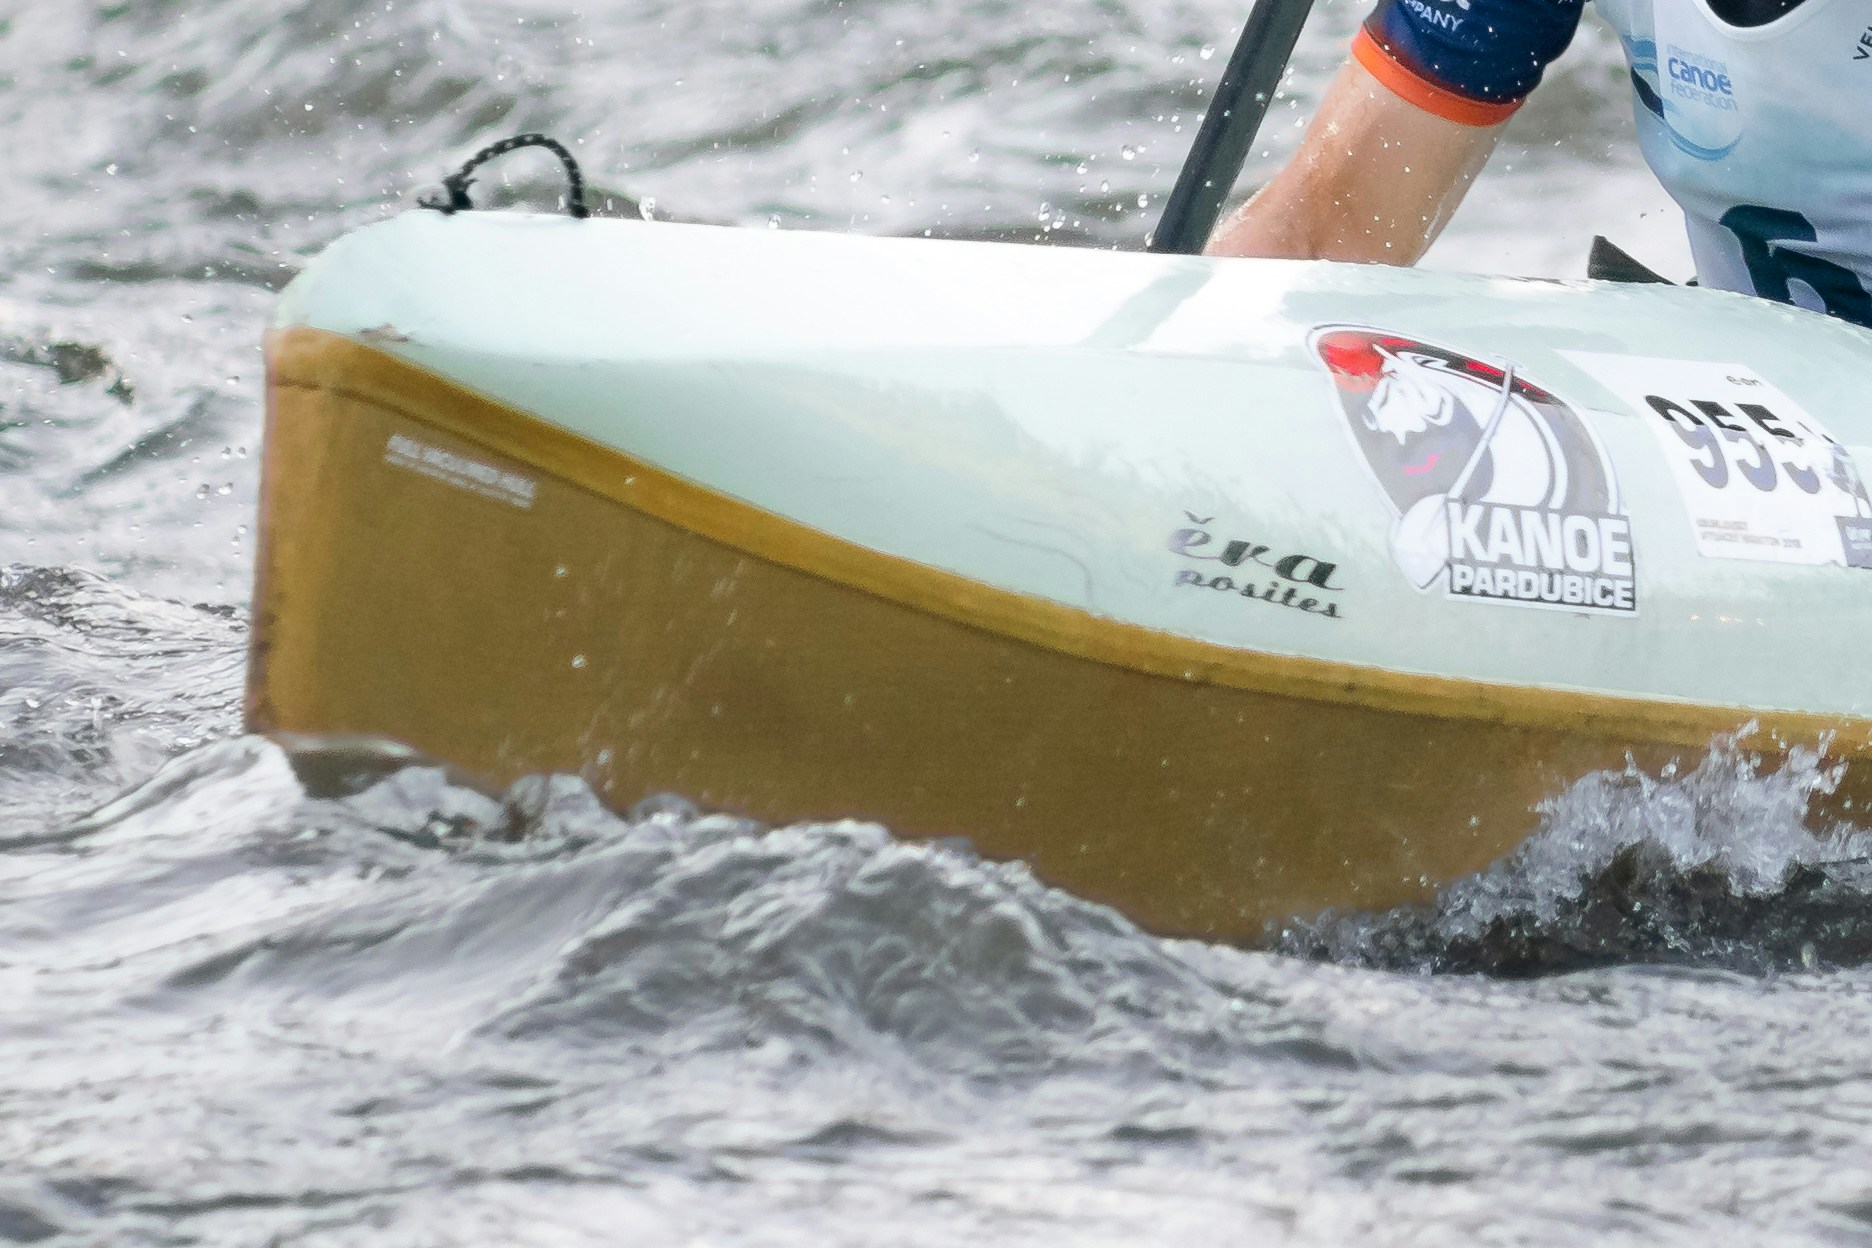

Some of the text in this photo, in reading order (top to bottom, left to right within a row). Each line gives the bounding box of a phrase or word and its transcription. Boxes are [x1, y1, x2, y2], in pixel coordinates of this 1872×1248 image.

[1668, 56, 1733, 95] canoe
[1449, 502, 1633, 577] KANOE
[1452, 564, 1634, 609] PARDUBICE
